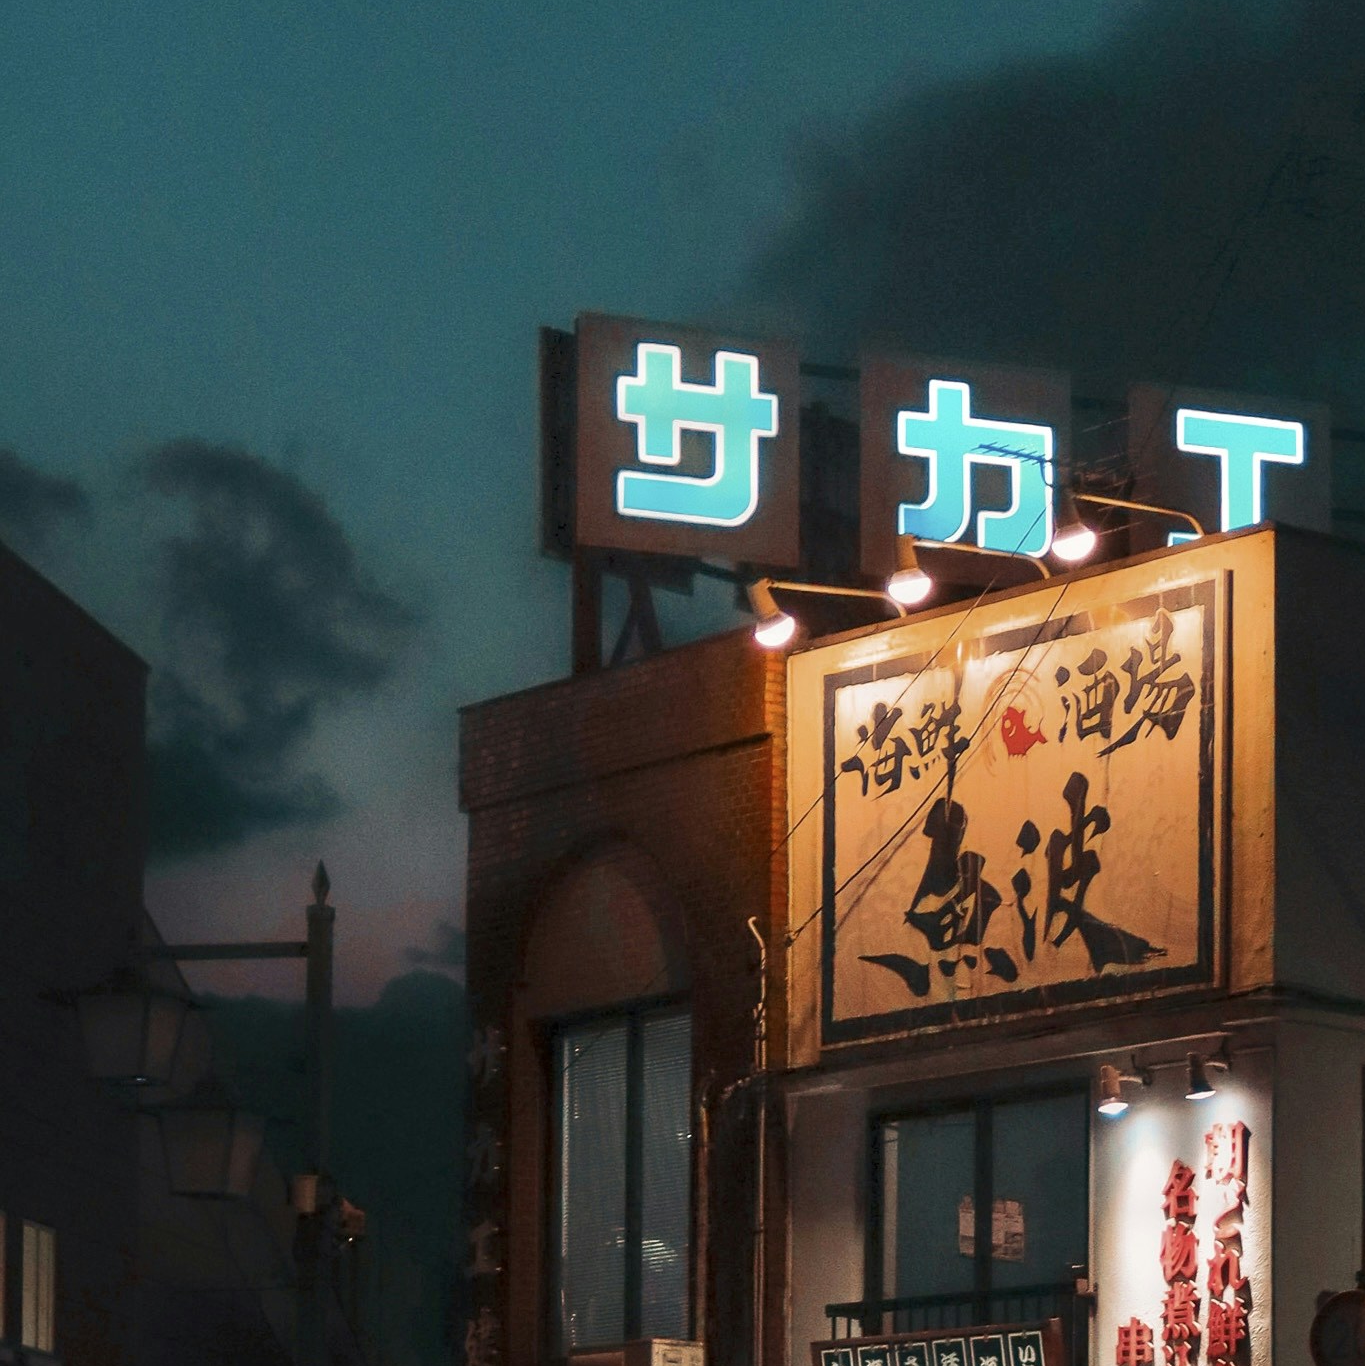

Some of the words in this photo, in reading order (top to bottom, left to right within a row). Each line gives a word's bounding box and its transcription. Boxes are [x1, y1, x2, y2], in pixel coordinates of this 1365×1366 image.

[842, 702, 970, 801] 海鮮
[1056, 611, 1197, 758] 酒場
[858, 771, 1168, 996] 魚波
